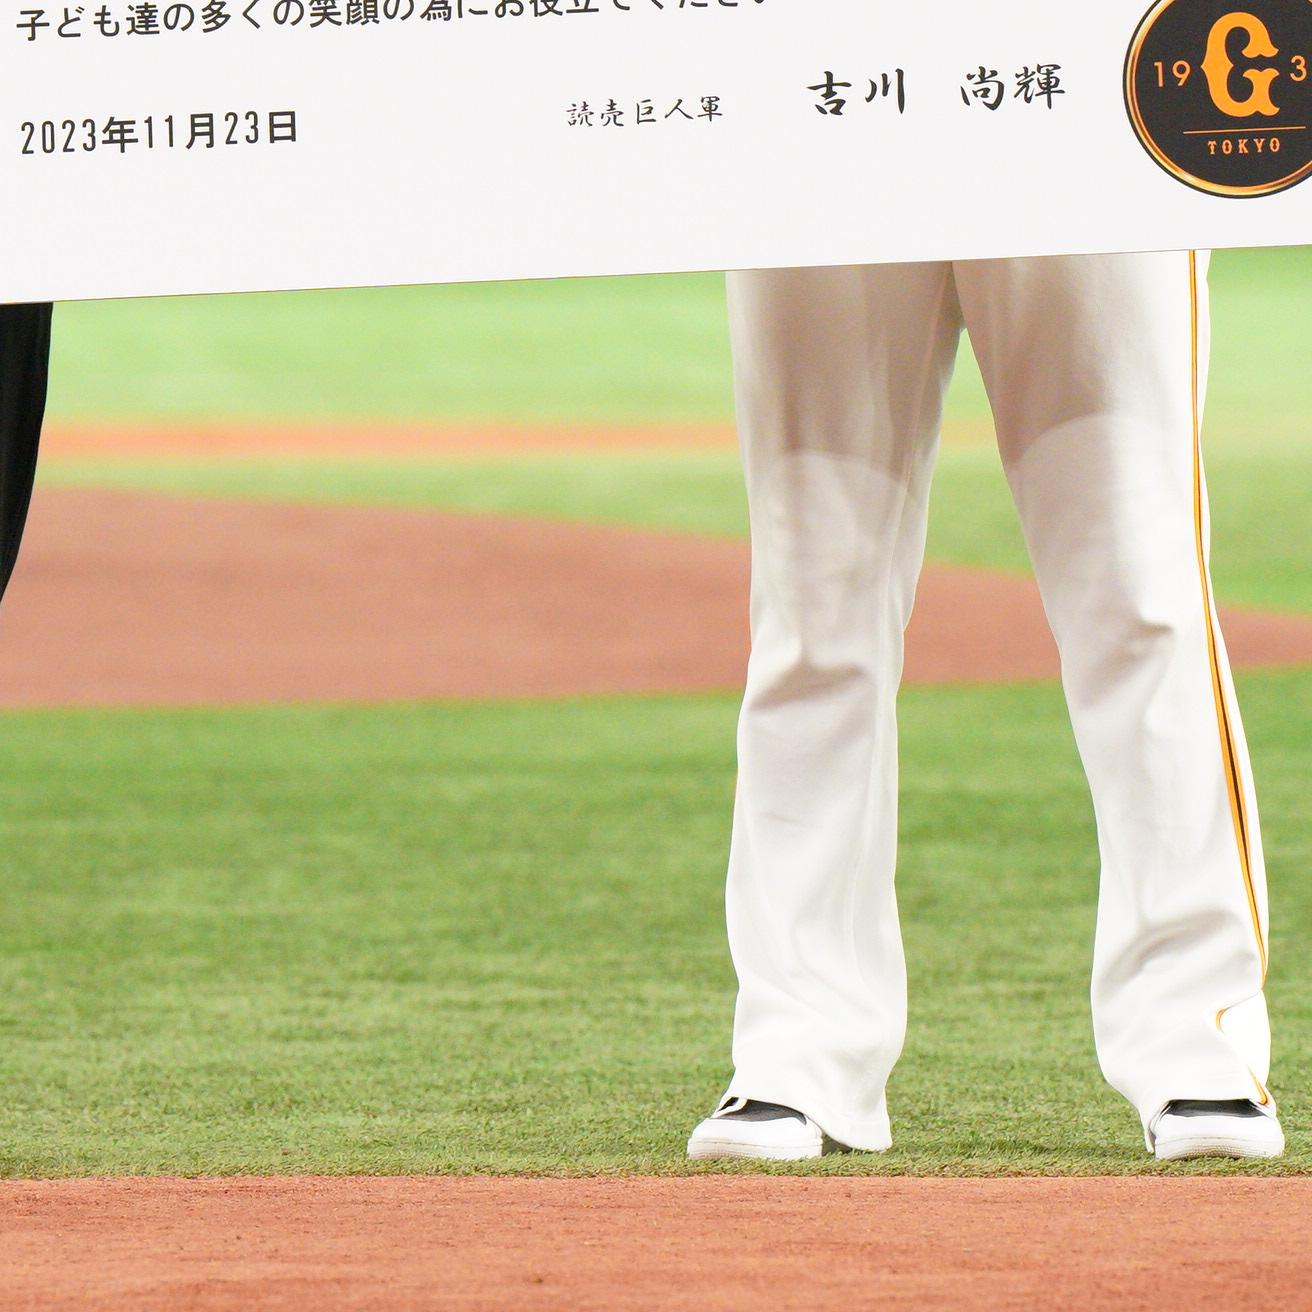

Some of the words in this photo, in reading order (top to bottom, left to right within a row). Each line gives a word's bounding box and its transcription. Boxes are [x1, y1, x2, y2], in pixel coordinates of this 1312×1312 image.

[1153, 60, 1191, 88] 19
[1200, 11, 1280, 118] G
[566, 95, 723, 127] 読売巨人軍
[806, 68, 905, 116] 吉川
[960, 63, 1066, 111] 尚輝
[21, 110, 297, 155] 2023年11月23日
[1207, 137, 1281, 155] TOKYO
